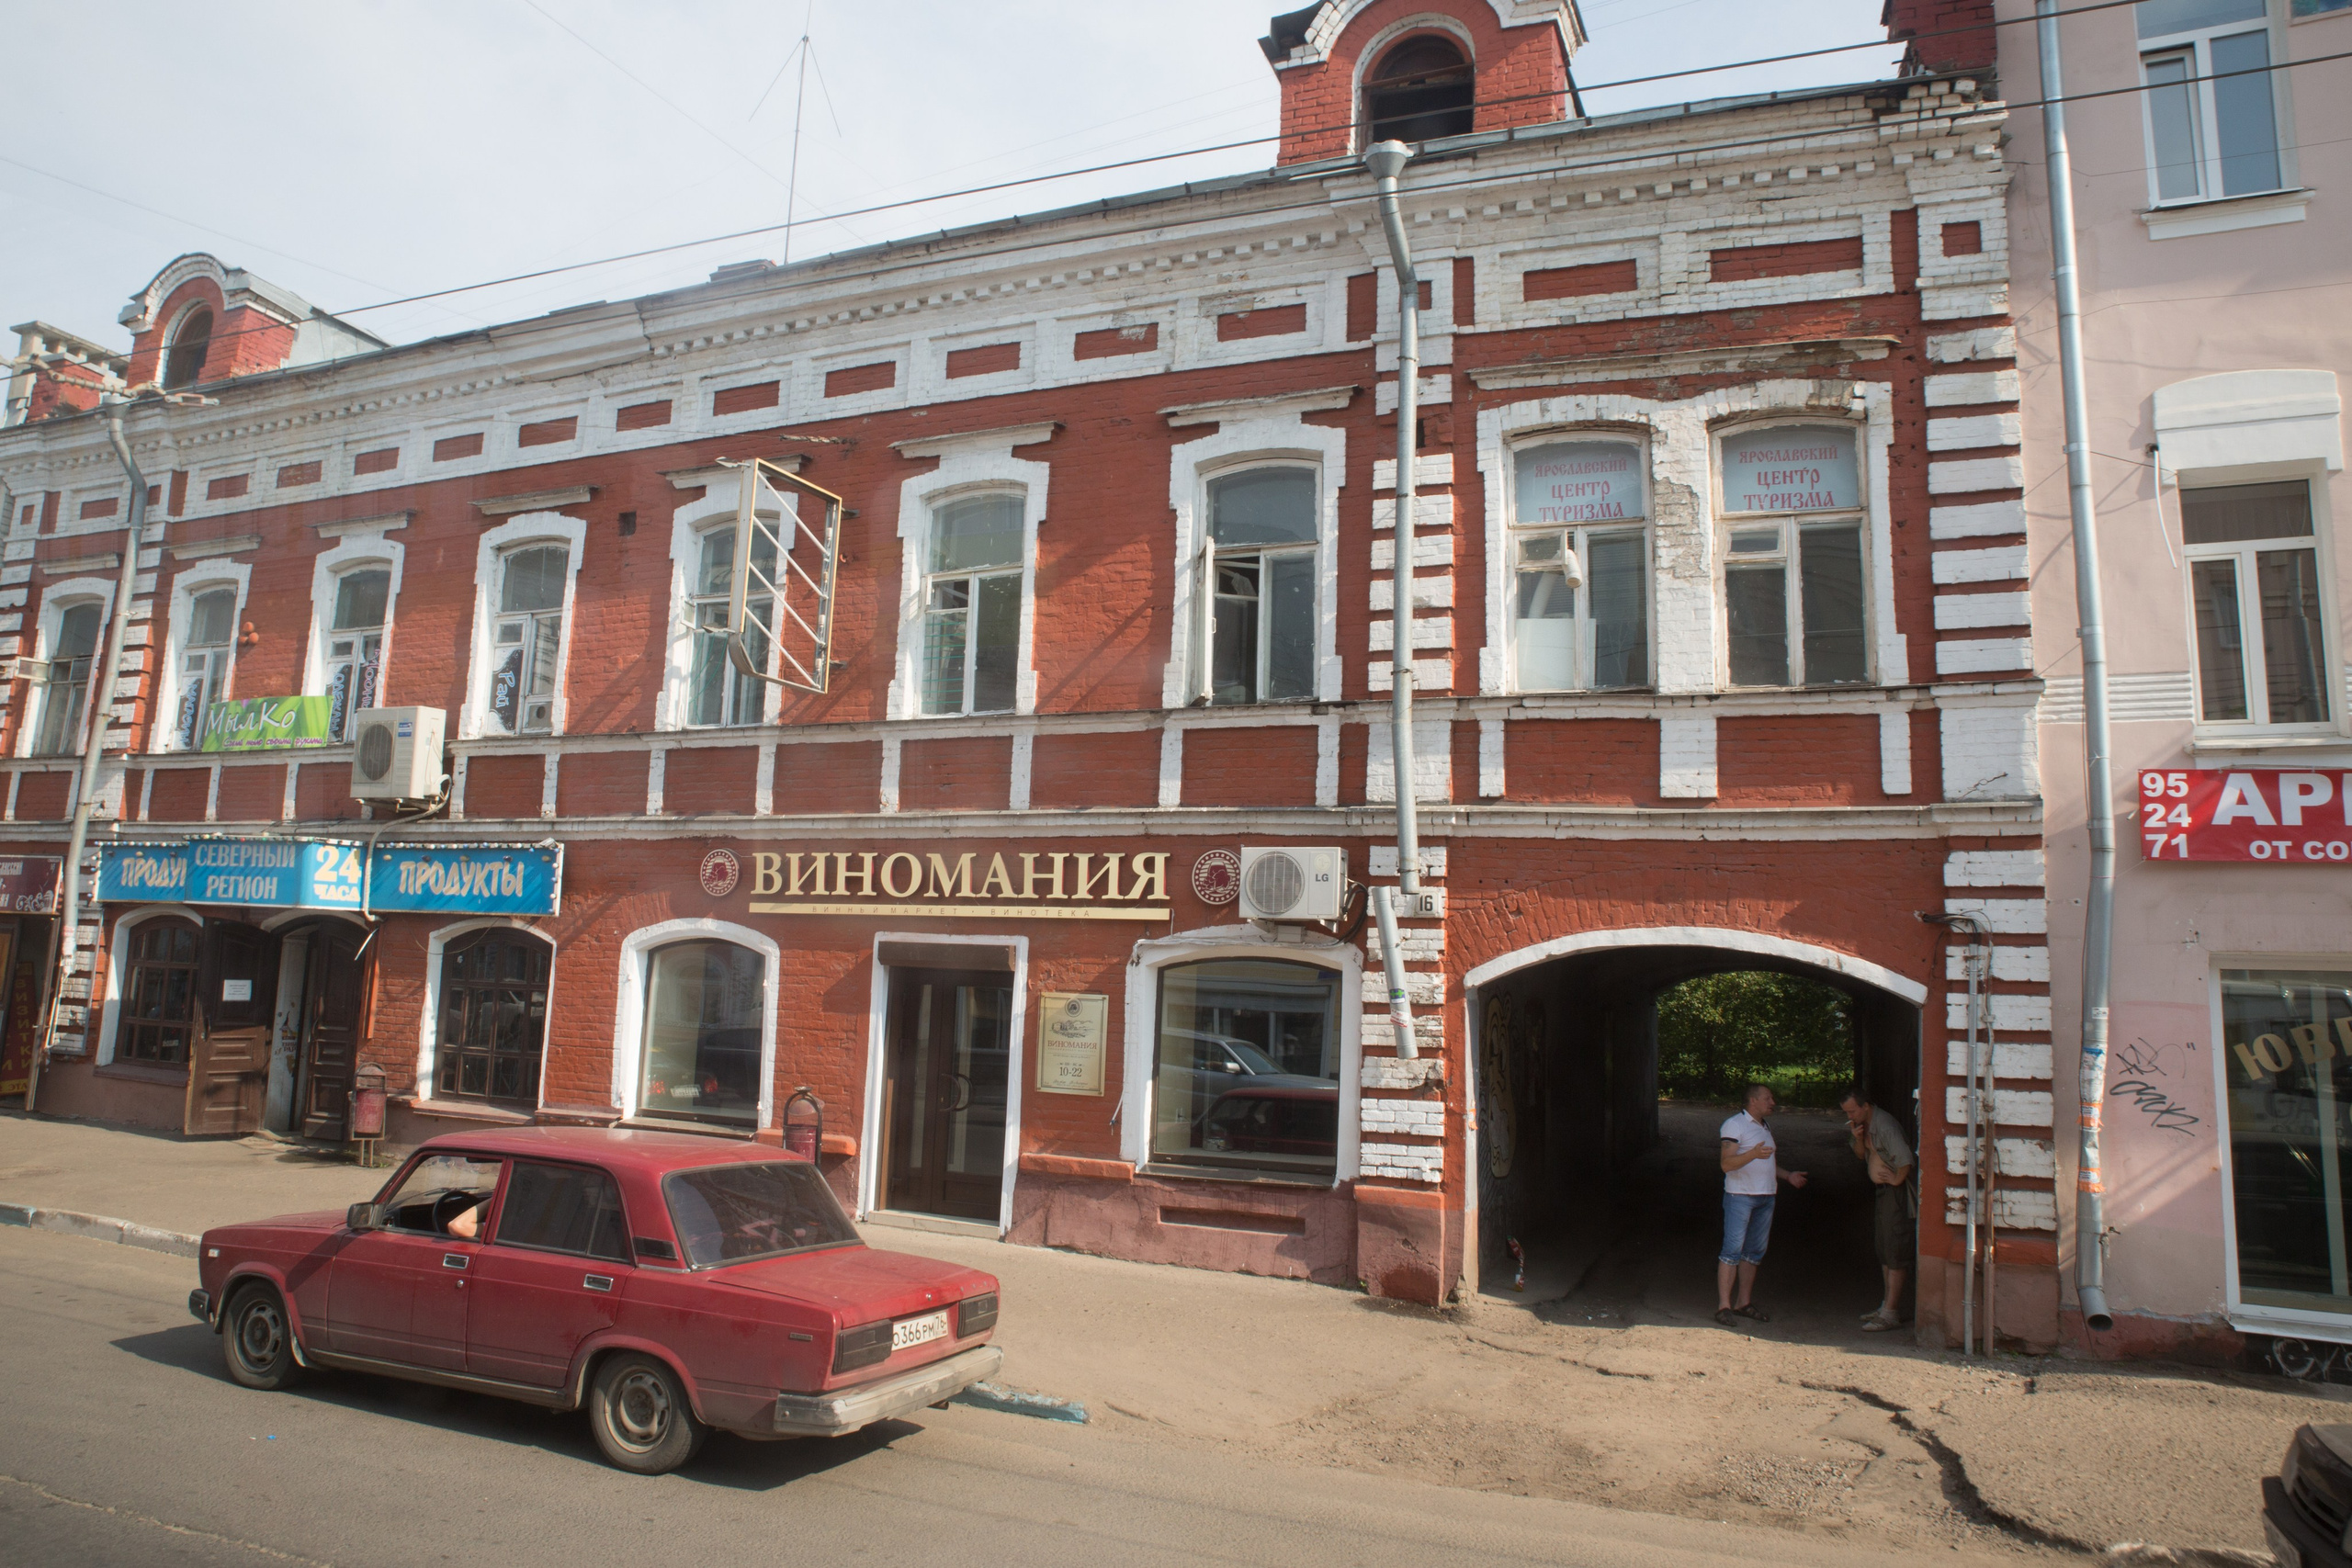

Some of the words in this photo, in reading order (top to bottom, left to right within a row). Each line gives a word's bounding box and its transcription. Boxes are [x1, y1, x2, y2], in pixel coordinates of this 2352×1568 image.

[1739, 446, 1838, 464] ЯРОСЛАВСКИЙ
[1534, 458, 1627, 478] ЯРОСЛАВСКИЙ
[1757, 468, 1820, 491] ЦЕНТР
[1552, 480, 1611, 502] ЦЕНТР
[1744, 491, 1836, 511] ТУРИЗМА
[1539, 502, 1624, 522] ТУРИЗМА
[2142, 773, 2188, 797] 95
[2211, 773, 2352, 826] АР
[2143, 803, 2192, 828] 24
[195, 843, 296, 868] СЕВЕРНЫЙ
[2145, 833, 2188, 858] 71
[2302, 840, 2352, 861] СО
[120, 858, 187, 888] ПРОДУ
[313, 846, 363, 884] 24
[399, 861, 525, 897] ПРОДУКТЫ
[751, 852, 1170, 900] ВИНОМАНИЯ
[1315, 874, 1329, 882] LG
[206, 875, 278, 899] РЕГИОН
[313, 884, 361, 902] ЧАСА
[890, 907, 957, 915] МАРКЕТ
[990, 908, 1091, 918] ВИНОТЕКА
[1419, 895, 1433, 912] 16
[1047, 1040, 1097, 1050] ВИНОМАНИЯ
[1059, 1066, 1082, 1077] 10-22
[9, 1082, 28, 1091] ЭТА
